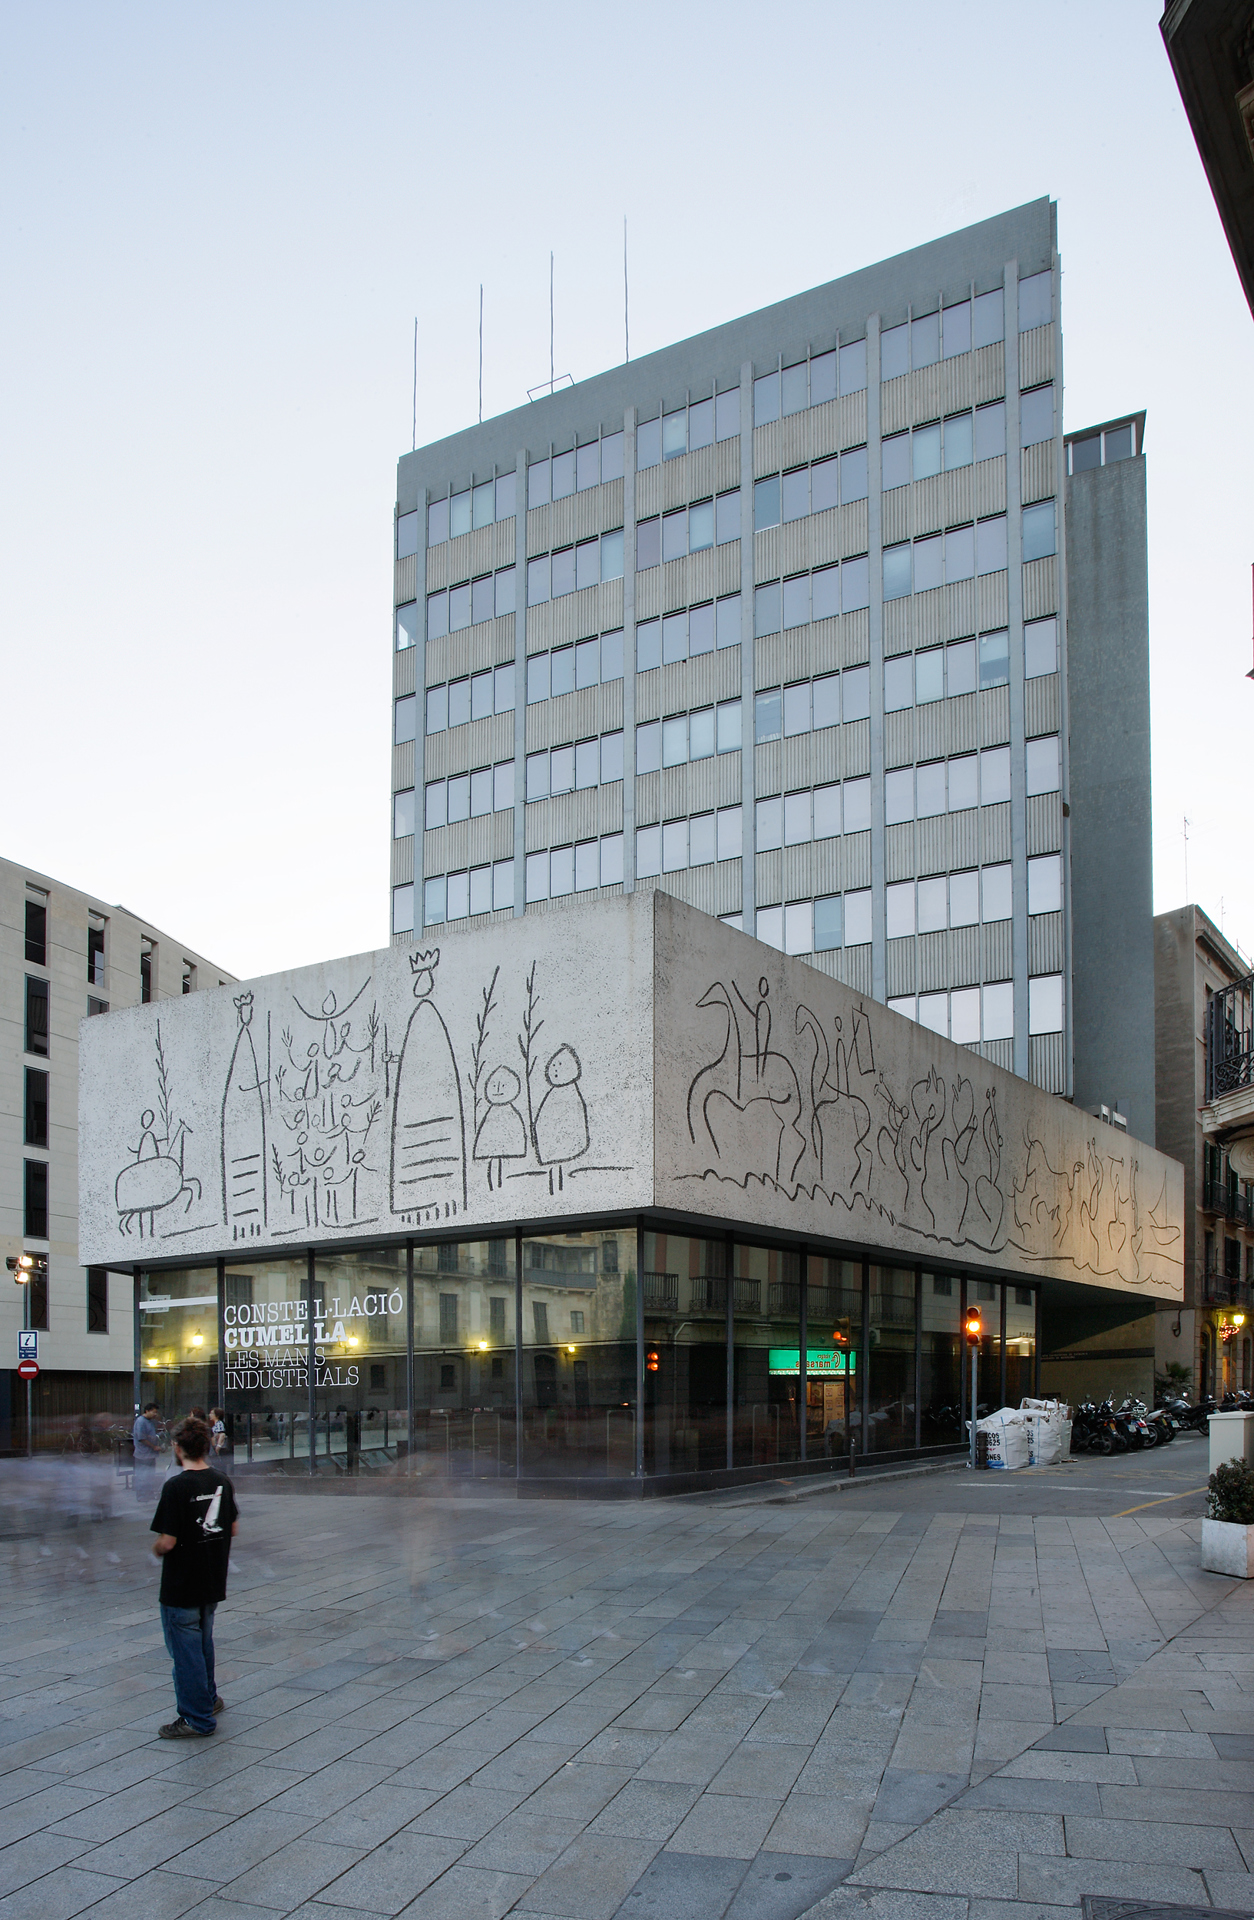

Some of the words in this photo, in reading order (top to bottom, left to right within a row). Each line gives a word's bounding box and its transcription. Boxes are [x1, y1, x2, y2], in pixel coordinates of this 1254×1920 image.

[224, 1321, 348, 1348] CUMELLA
[225, 1350, 260, 1369] LES
[263, 1346, 326, 1368] MANS
[225, 1365, 360, 1390] INDUSTRIALS
